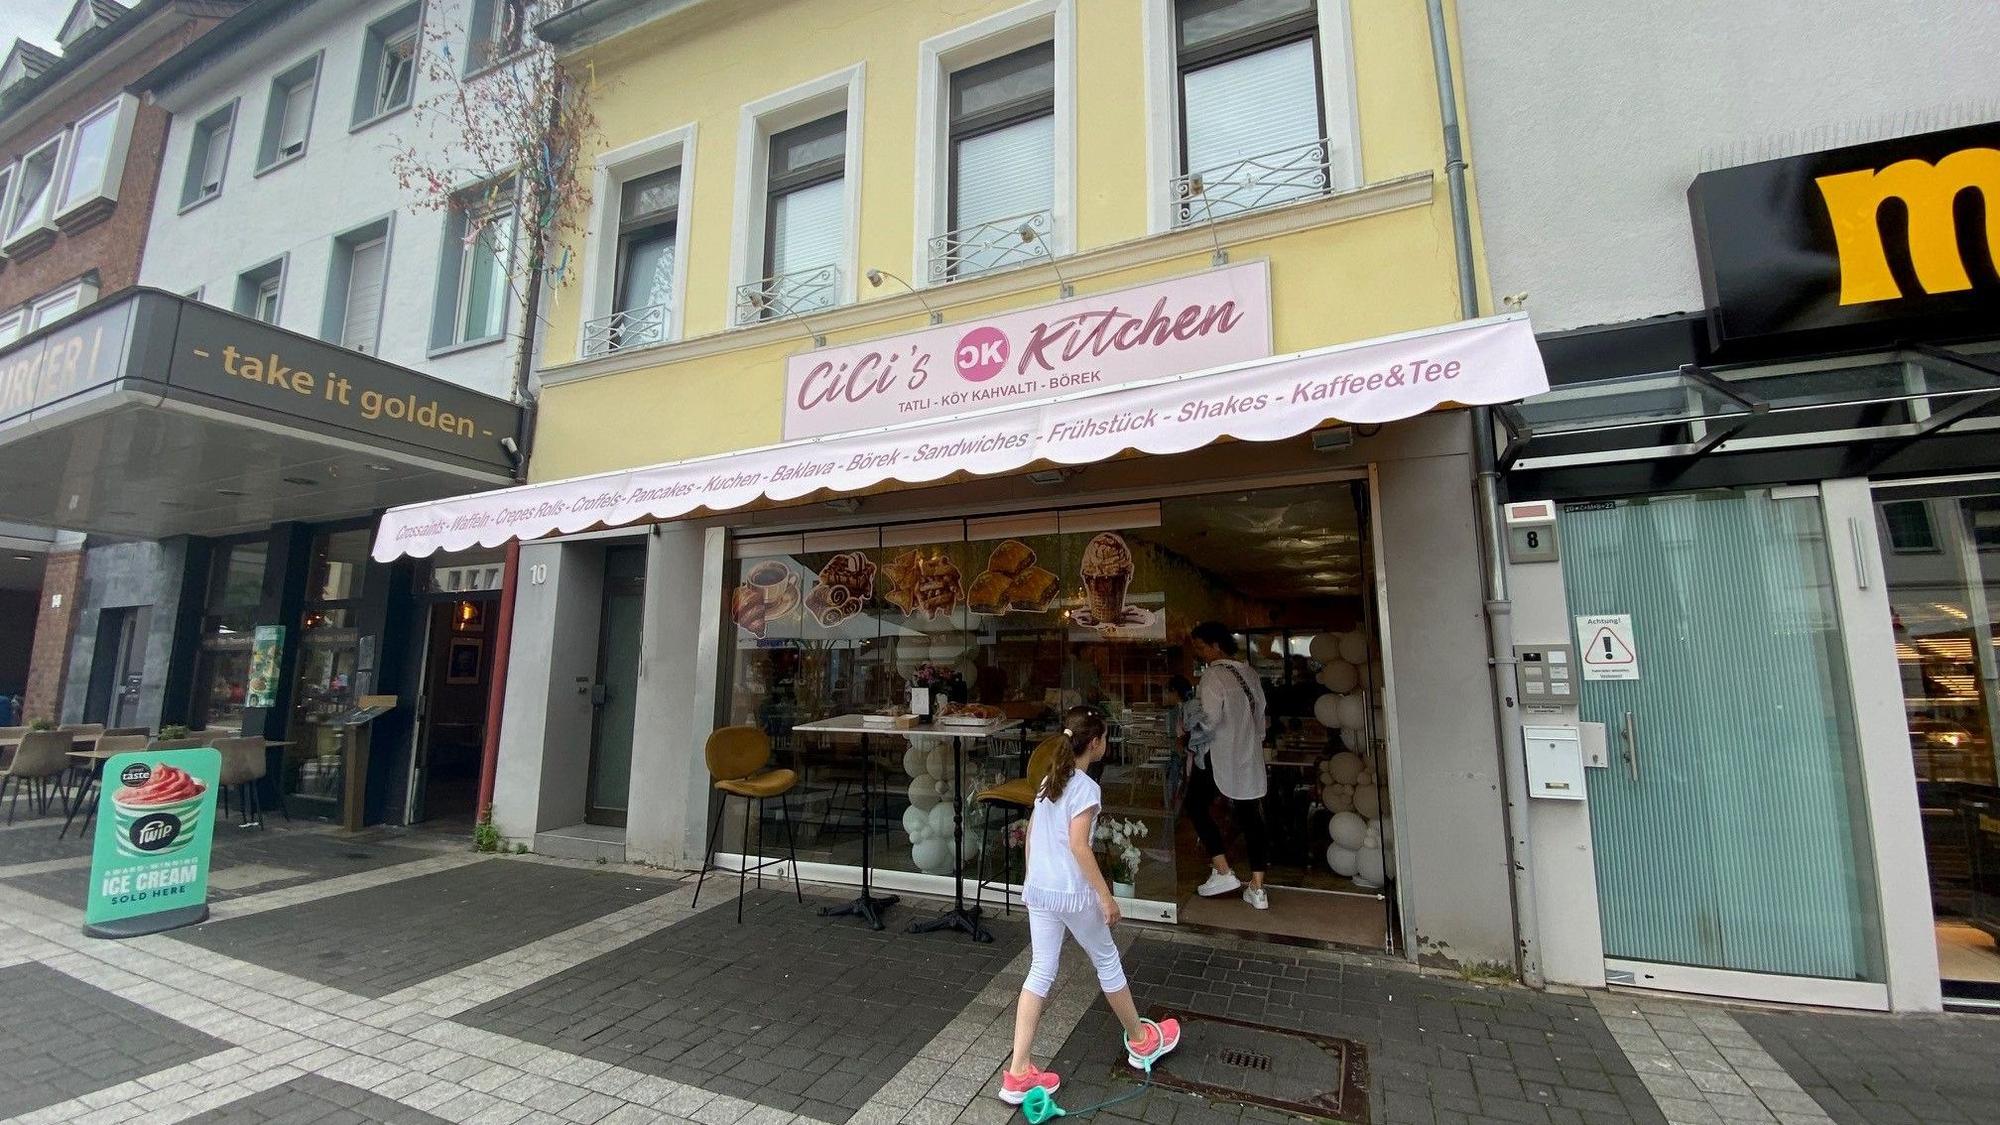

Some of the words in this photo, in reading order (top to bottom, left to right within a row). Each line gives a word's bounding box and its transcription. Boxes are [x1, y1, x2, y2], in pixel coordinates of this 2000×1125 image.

[798, 345, 931, 410] CiCi's
[1018, 296, 1243, 375] Kitchen
[223, 345, 315, 395] take
[325, 372, 352, 405] it
[360, 389, 474, 439] golden
[898, 399, 930, 413] TATLI
[941, 392, 968, 405] KÖY
[972, 381, 1037, 402] KAHVALTI
[1049, 370, 1101, 390] BÖREK
[450, 512, 489, 532] Waffeln
[496, 508, 534, 527] Crepes
[534, 502, 565, 518] Rolls
[571, 492, 622, 514] Croffels
[627, 482, 697, 505] Pancakes
[702, 471, 760, 493] Kuchen
[769, 459, 835, 484] Baklava
[847, 449, 901, 472] Börek
[913, 431, 1029, 462] Sandwiches
[1047, 407, 1157, 445] Frühstück
[1177, 391, 1269, 424] Shakes
[1291, 358, 1462, 405] Kaffee&Tee
[1526, 531, 1539, 549] 8
[530, 564, 547, 585] 10
[1587, 617, 1621, 625] Achtung!
[102, 875, 131, 897] ICE
[135, 864, 198, 891] CREAM
[111, 892, 147, 905] SOLD
[152, 885, 186, 898] HERE
